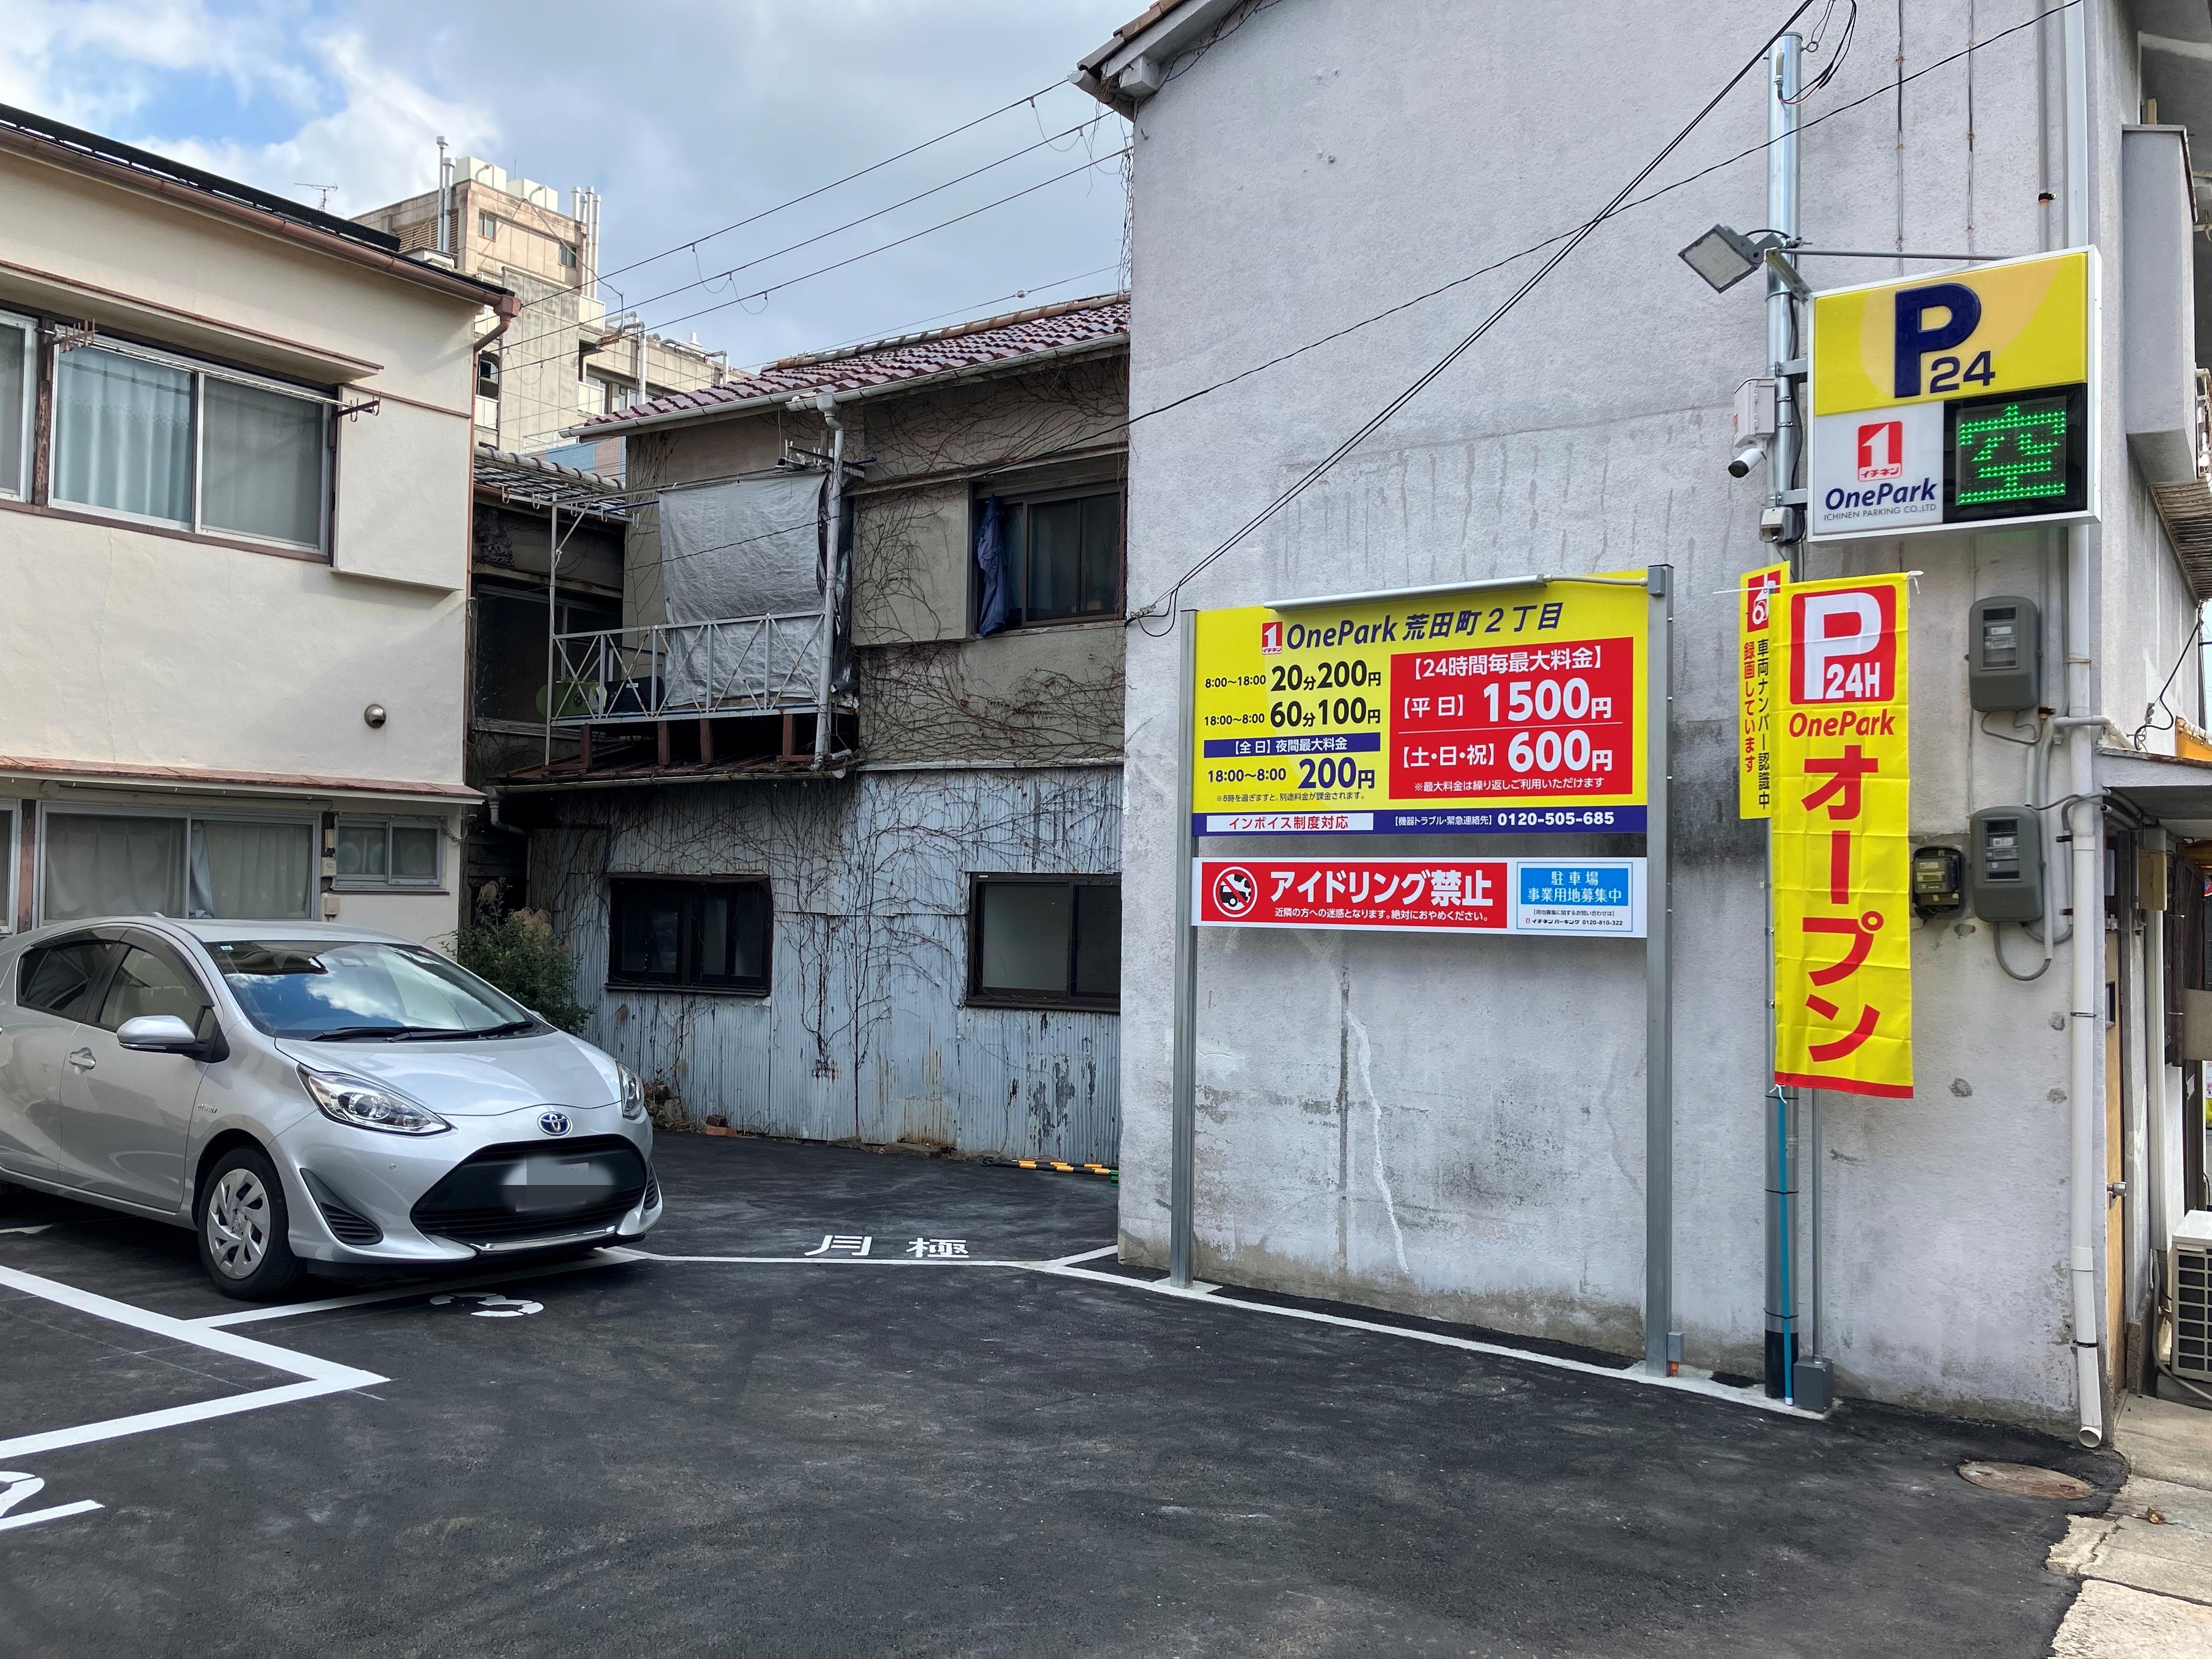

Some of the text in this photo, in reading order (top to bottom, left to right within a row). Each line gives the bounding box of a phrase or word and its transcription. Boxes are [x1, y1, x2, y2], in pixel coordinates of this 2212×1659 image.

[1895, 283, 1995, 399] P 24
[1959, 405, 2066, 505] 空
[1860, 467, 1899, 479] イチネン
[1825, 478, 1937, 510] OnePark
[1824, 511, 1859, 521] ICHINEN
[1863, 506, 1901, 516] PARKING
[1287, 601, 1563, 650] OnePark 荒田町2丁目
[1804, 592, 1882, 700] P 24H
[1415, 645, 1601, 680] 【24時間毎最大料金】
[1483, 677, 1612, 722] 1500円
[1789, 709, 1896, 737] OnePark
[1508, 730, 1612, 773] 600円
[1298, 757, 1375, 789] 200円
[1229, 815, 1349, 830] インボイス制度対応
[1498, 812, 1614, 825] 0120-505-685
[1270, 869, 1493, 907] アイドリング禁止
[1551, 871, 1599, 886] 駐車場
[1528, 888, 1622, 903] 事業用地募集中
[1801, 745, 1884, 1062] オープン
[804, 1235, 969, 1258] 月極
